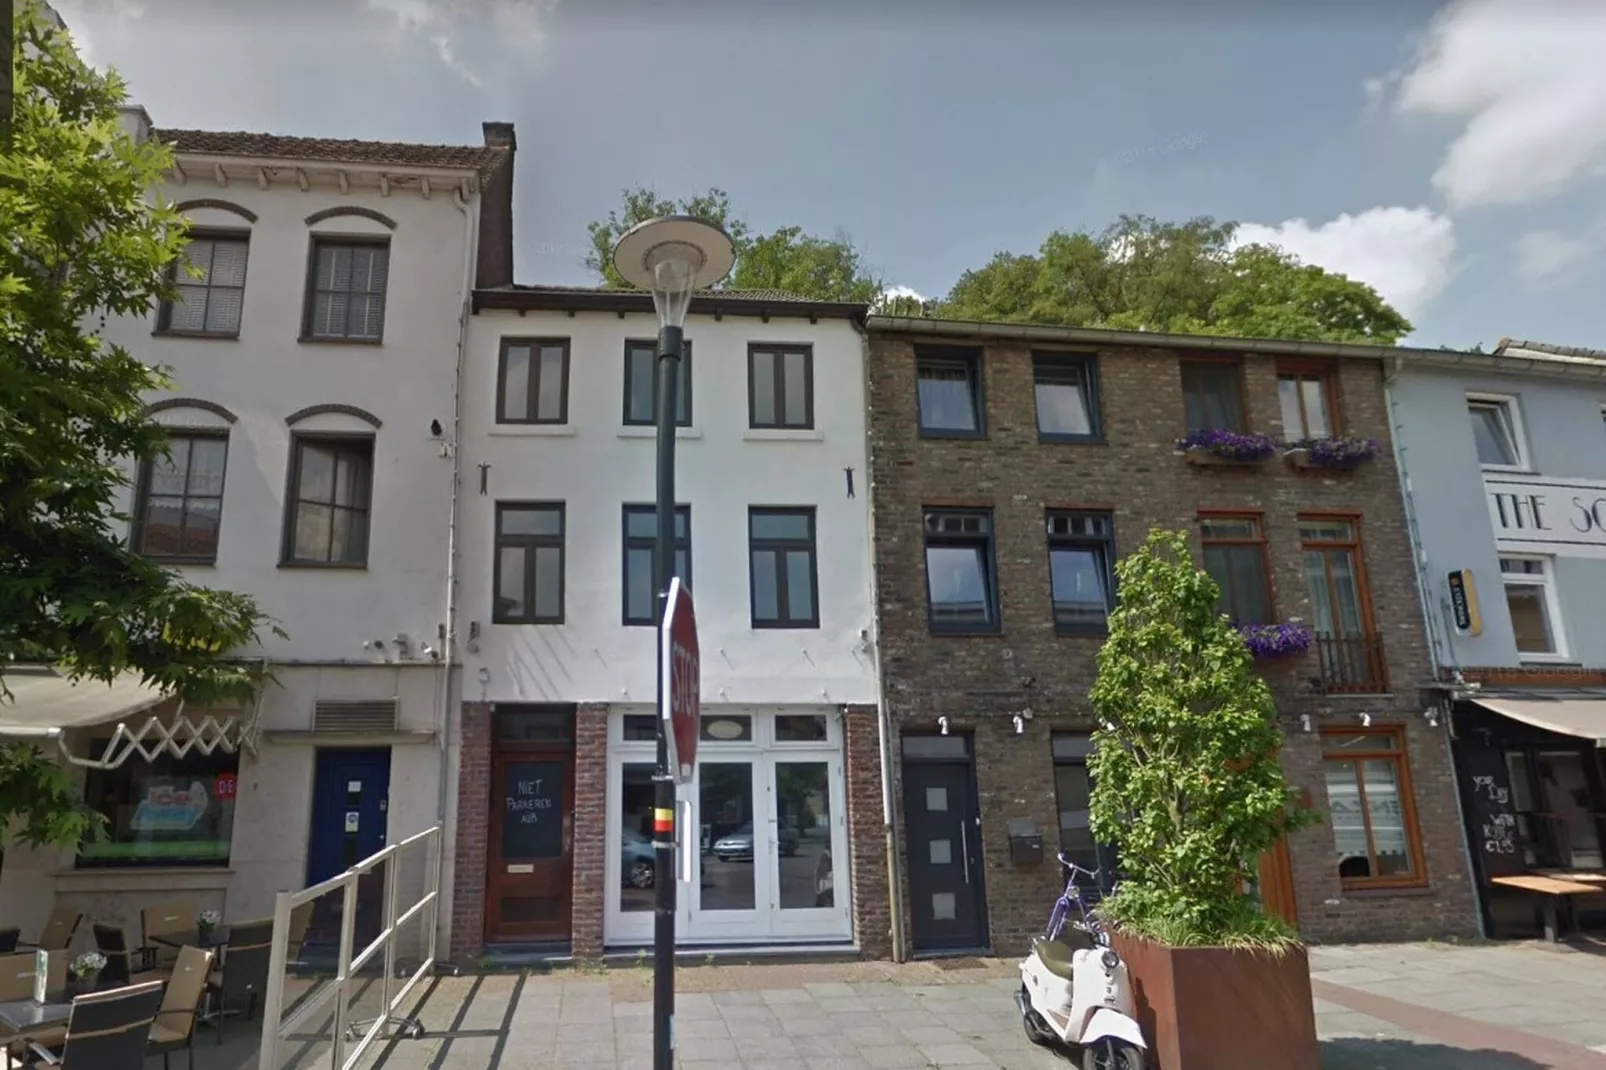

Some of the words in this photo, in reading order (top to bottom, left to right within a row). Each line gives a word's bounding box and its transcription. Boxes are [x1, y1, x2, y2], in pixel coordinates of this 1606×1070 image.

[1489, 492, 1553, 531] THE
[672, 643, 699, 715] STOP
[517, 778, 543, 796] NIET
[506, 797, 552, 812] PARKEREN
